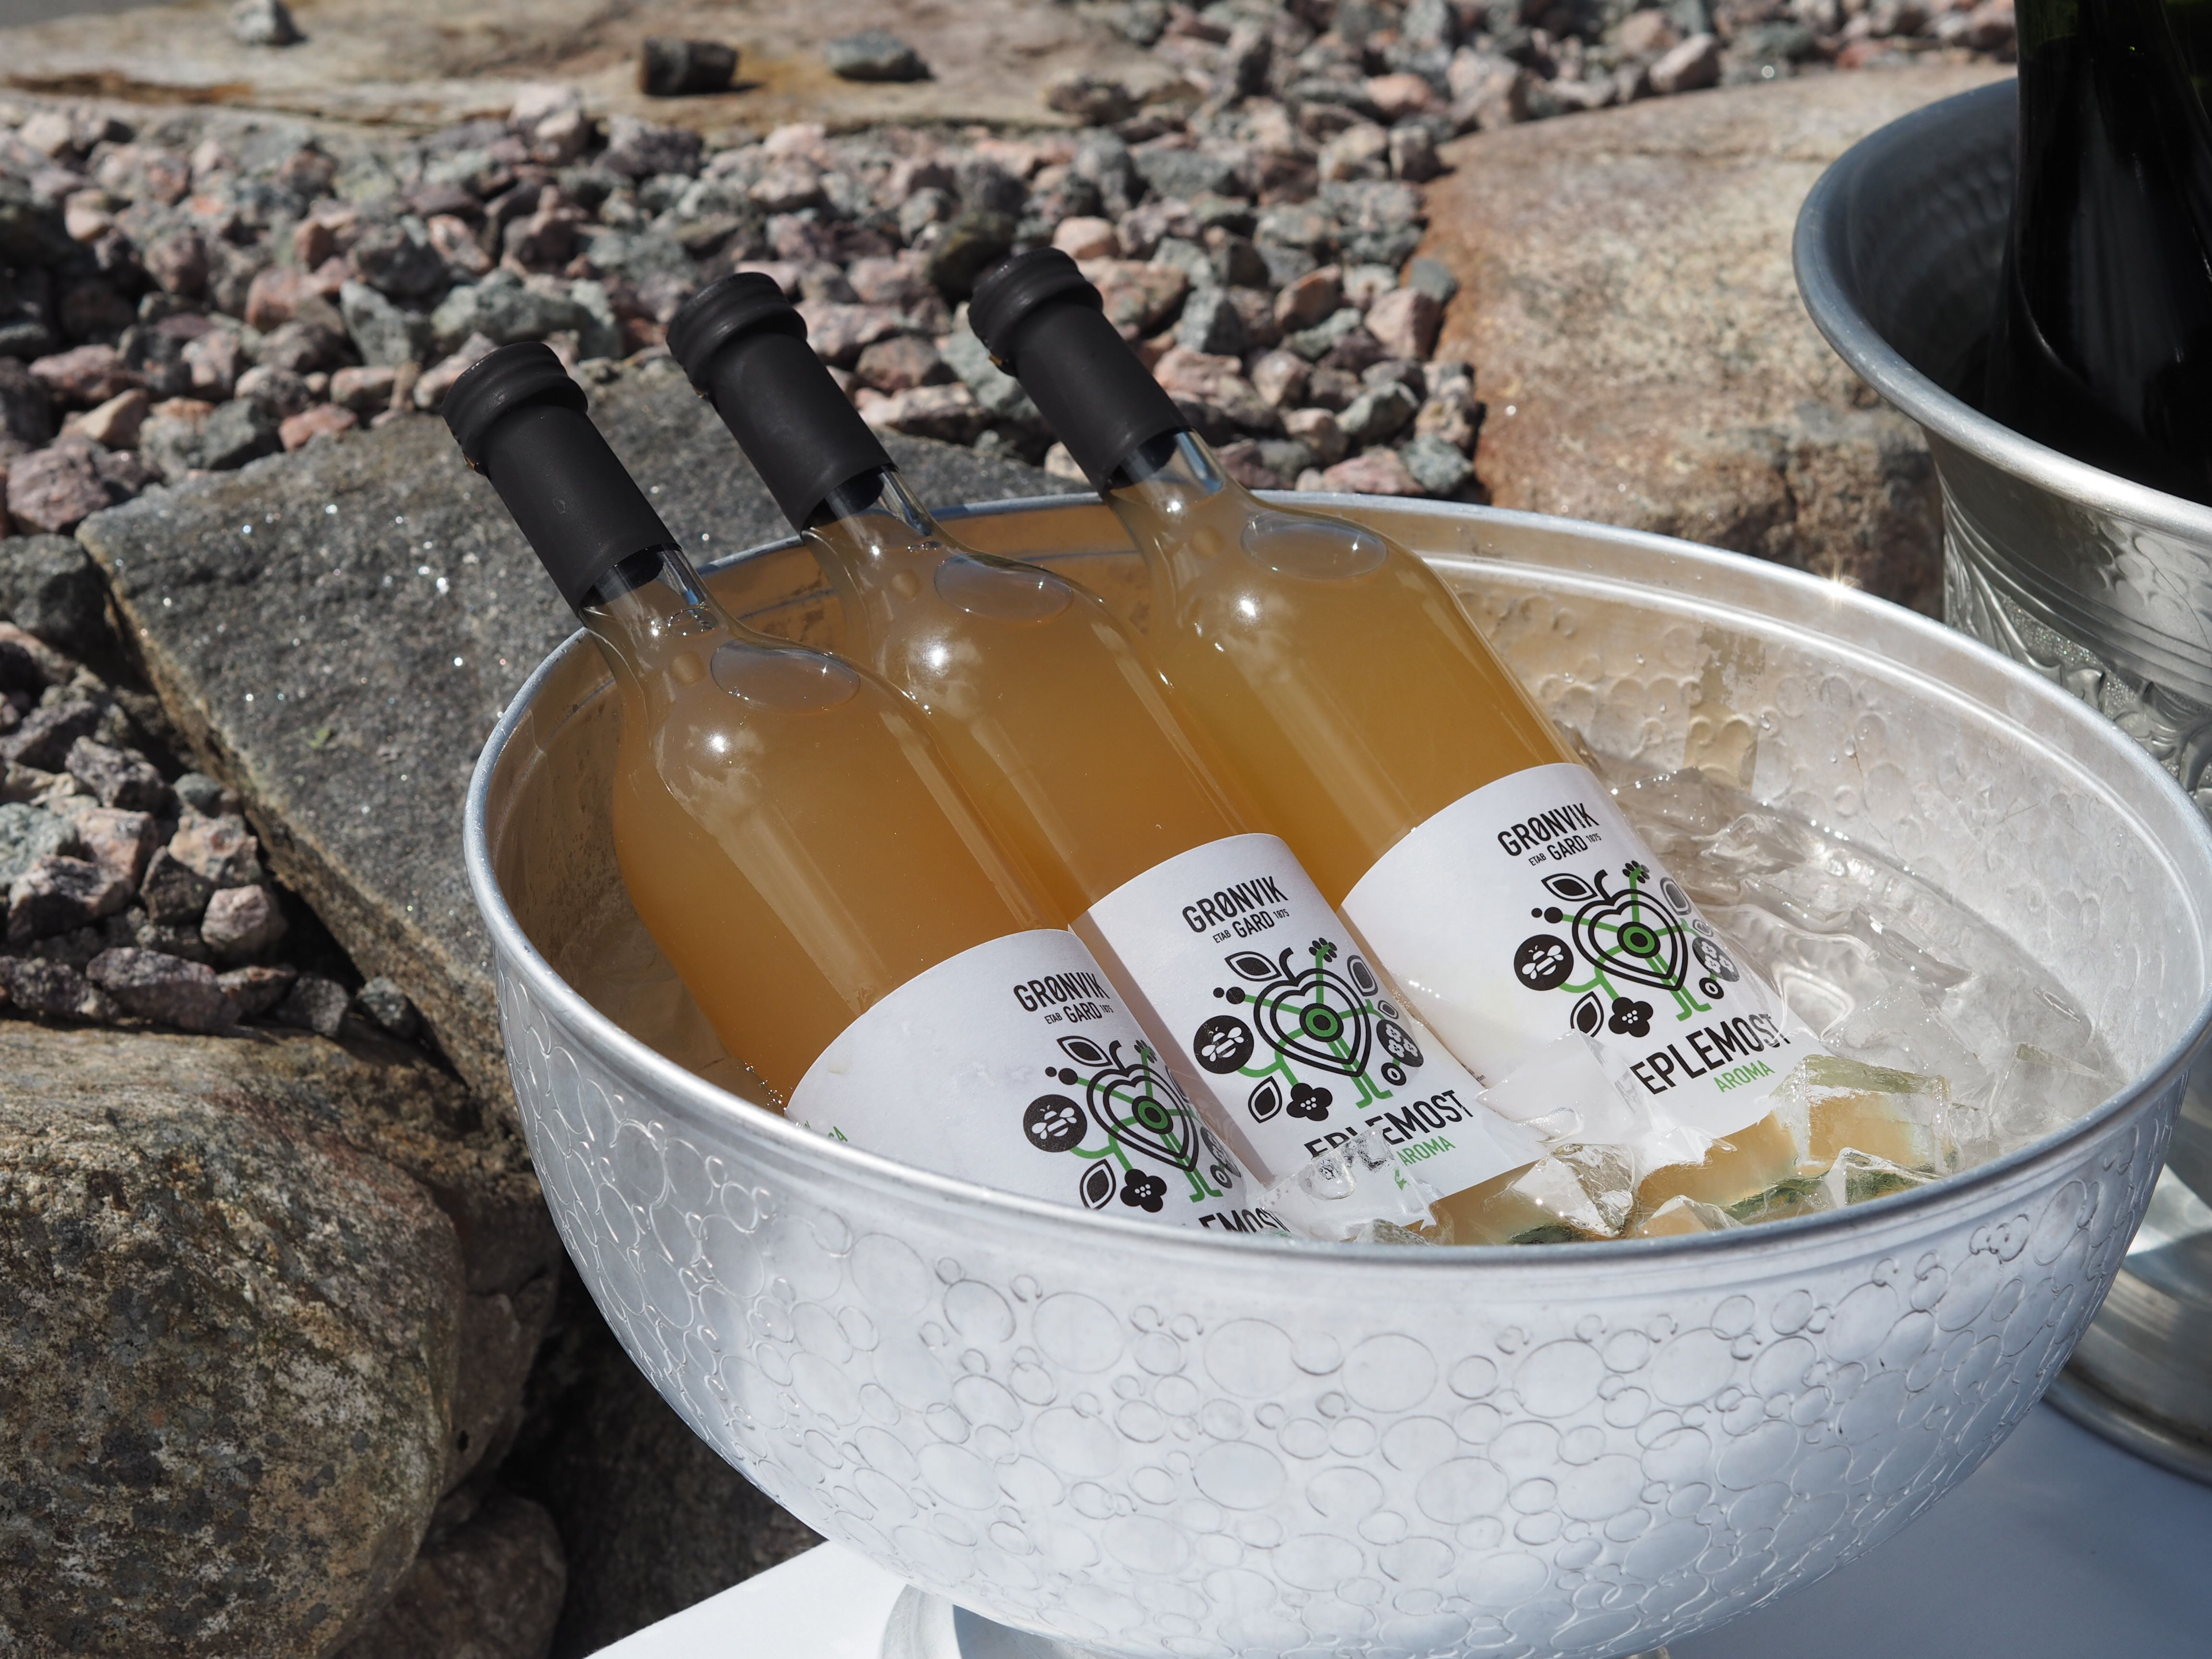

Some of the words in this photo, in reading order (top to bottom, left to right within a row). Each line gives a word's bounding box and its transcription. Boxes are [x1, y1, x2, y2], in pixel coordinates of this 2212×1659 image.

[1498, 803, 1599, 856] GRØNVIK
[1528, 853, 1547, 866] ETAB
[1547, 835, 1588, 860] GARD
[1586, 833, 1602, 843] 1875
[1182, 876, 1288, 933] GRØNVIK
[1213, 929, 1231, 943] ETAB
[1232, 911, 1275, 938] GARD
[1273, 909, 1290, 919] 1875
[1013, 972, 1110, 1011] GRØNVIK
[1044, 1012, 1063, 1024] ETAB
[1063, 1002, 1103, 1023] GARD
[1629, 1013, 1791, 1094] EPLEMOST
[1713, 1059, 1775, 1093] AROMA
[1396, 1135, 1456, 1166] AROMA
